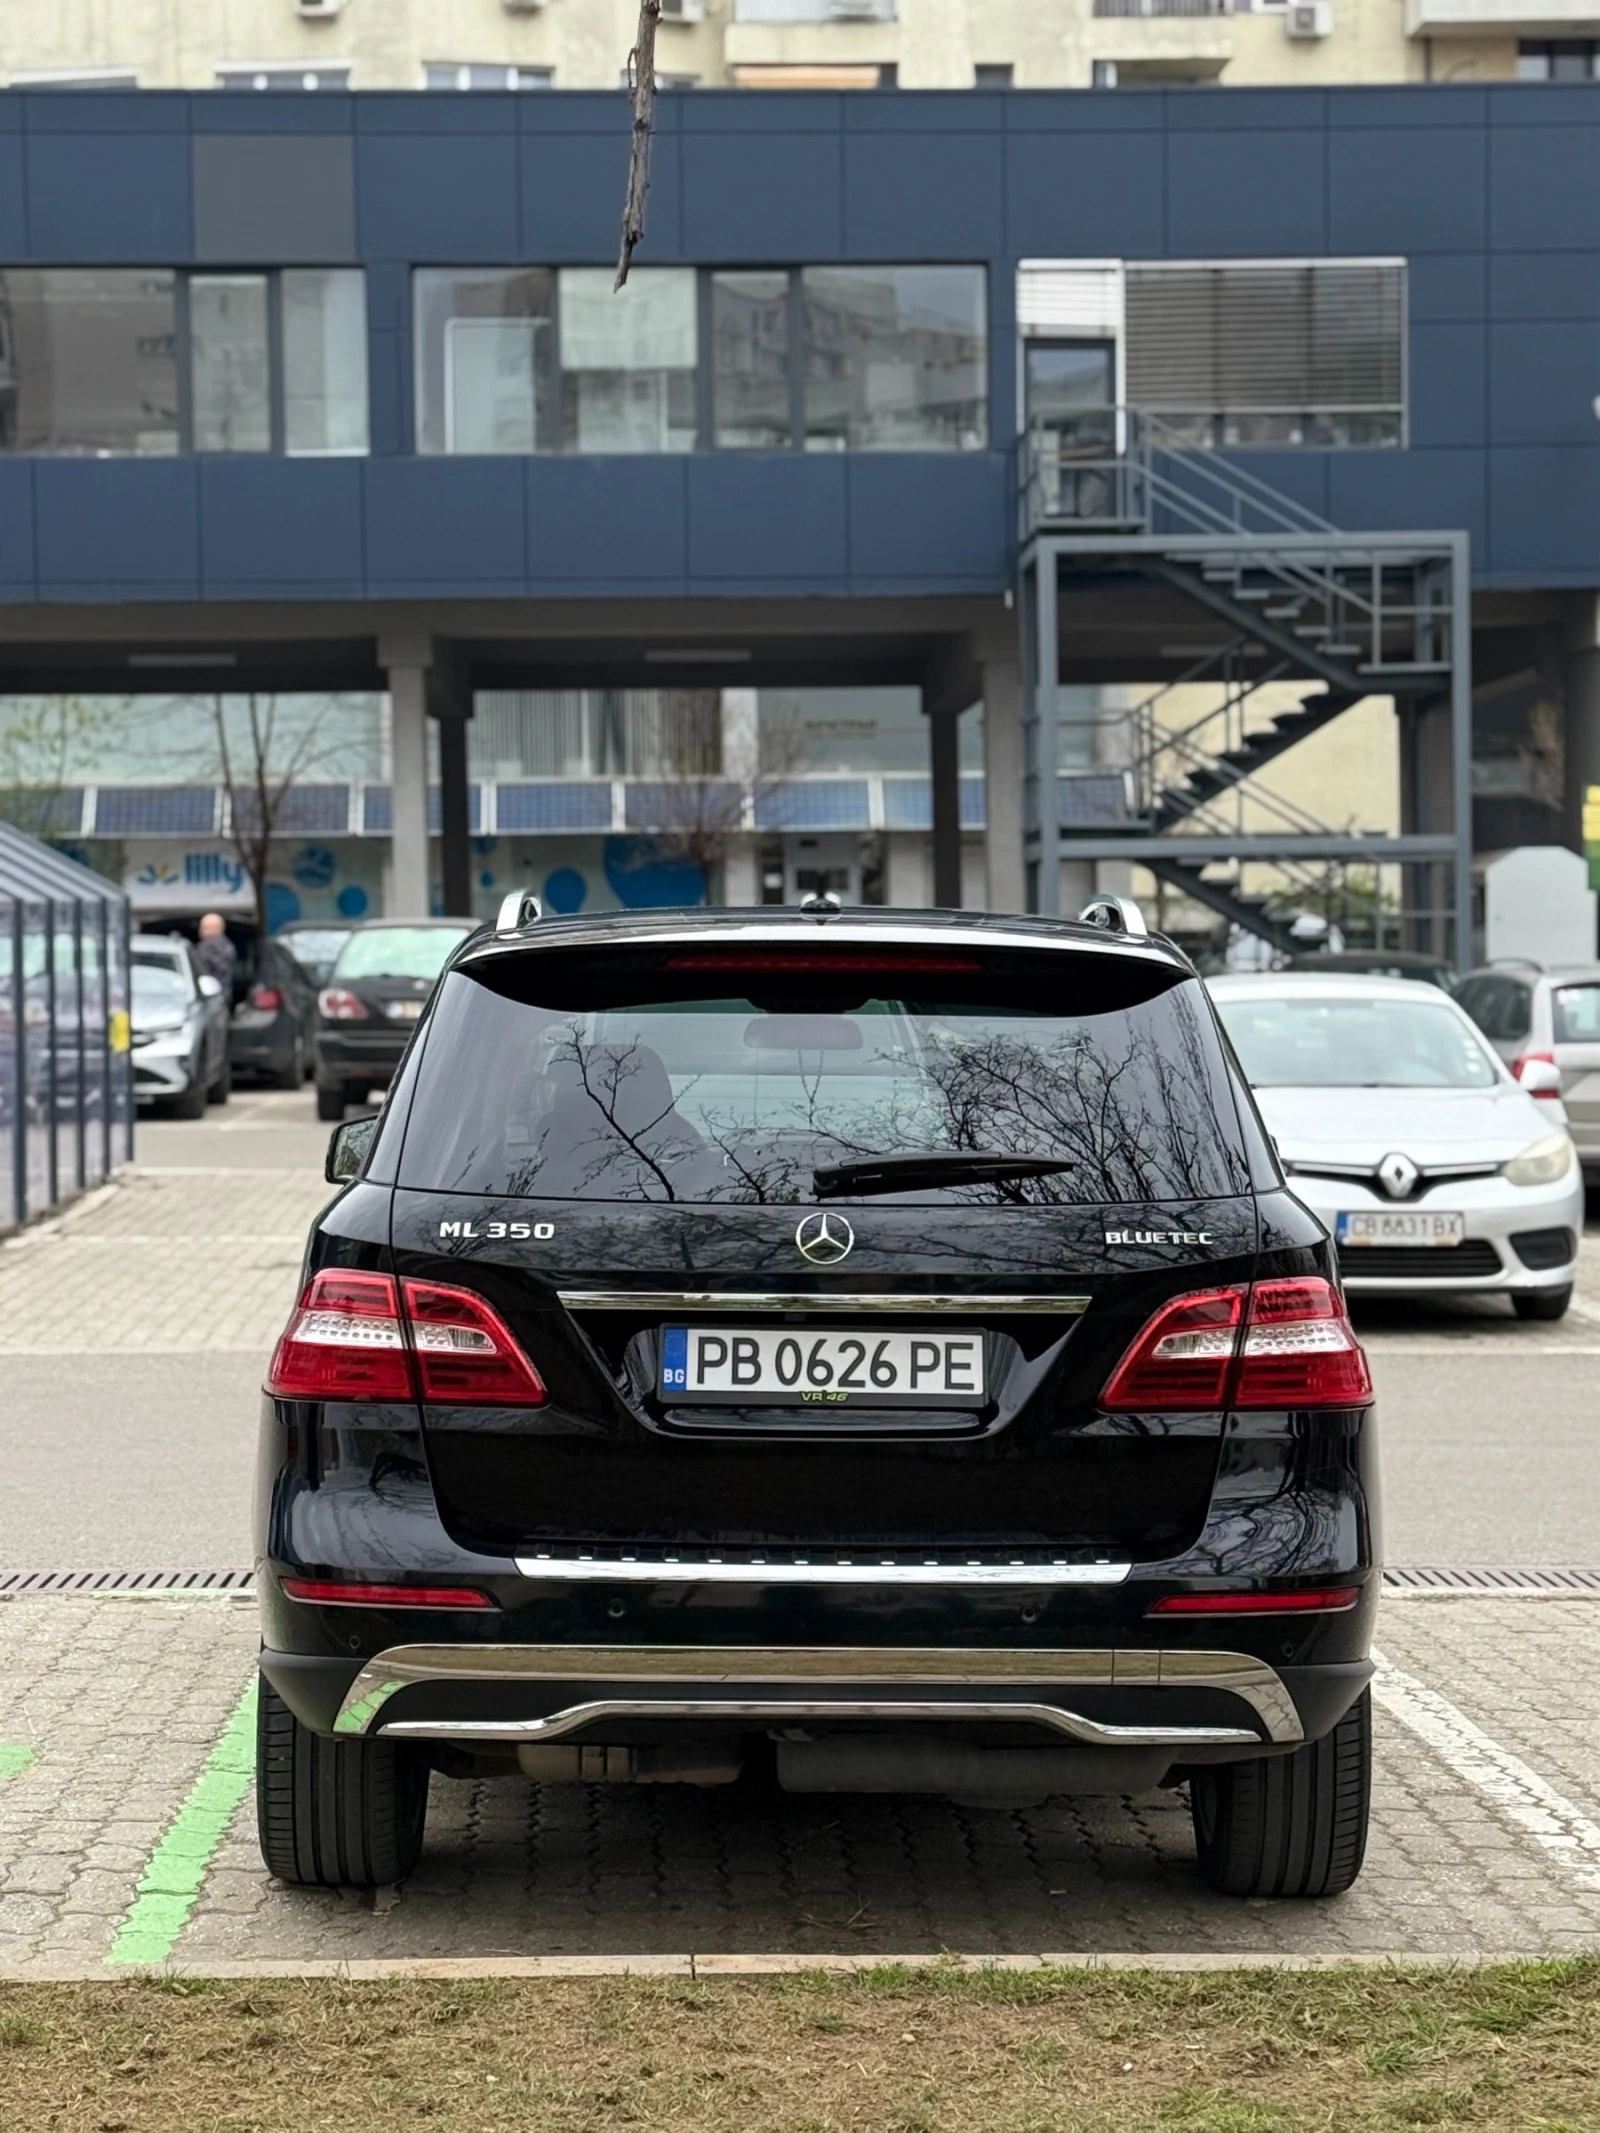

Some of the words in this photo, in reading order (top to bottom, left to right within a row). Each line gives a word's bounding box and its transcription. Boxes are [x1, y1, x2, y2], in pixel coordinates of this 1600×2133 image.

[185, 853, 243, 894] lilly
[440, 1221, 480, 1238] ML
[486, 1222, 555, 1240] 350
[1105, 1229, 1214, 1245] BLUETEC
[697, 1336, 762, 1386] PB
[775, 1338, 898, 1388] 0626
[909, 1341, 975, 1391] PE
[663, 1368, 685, 1384] BG
[801, 1392, 823, 1402] VR
[826, 1392, 849, 1402] 46
